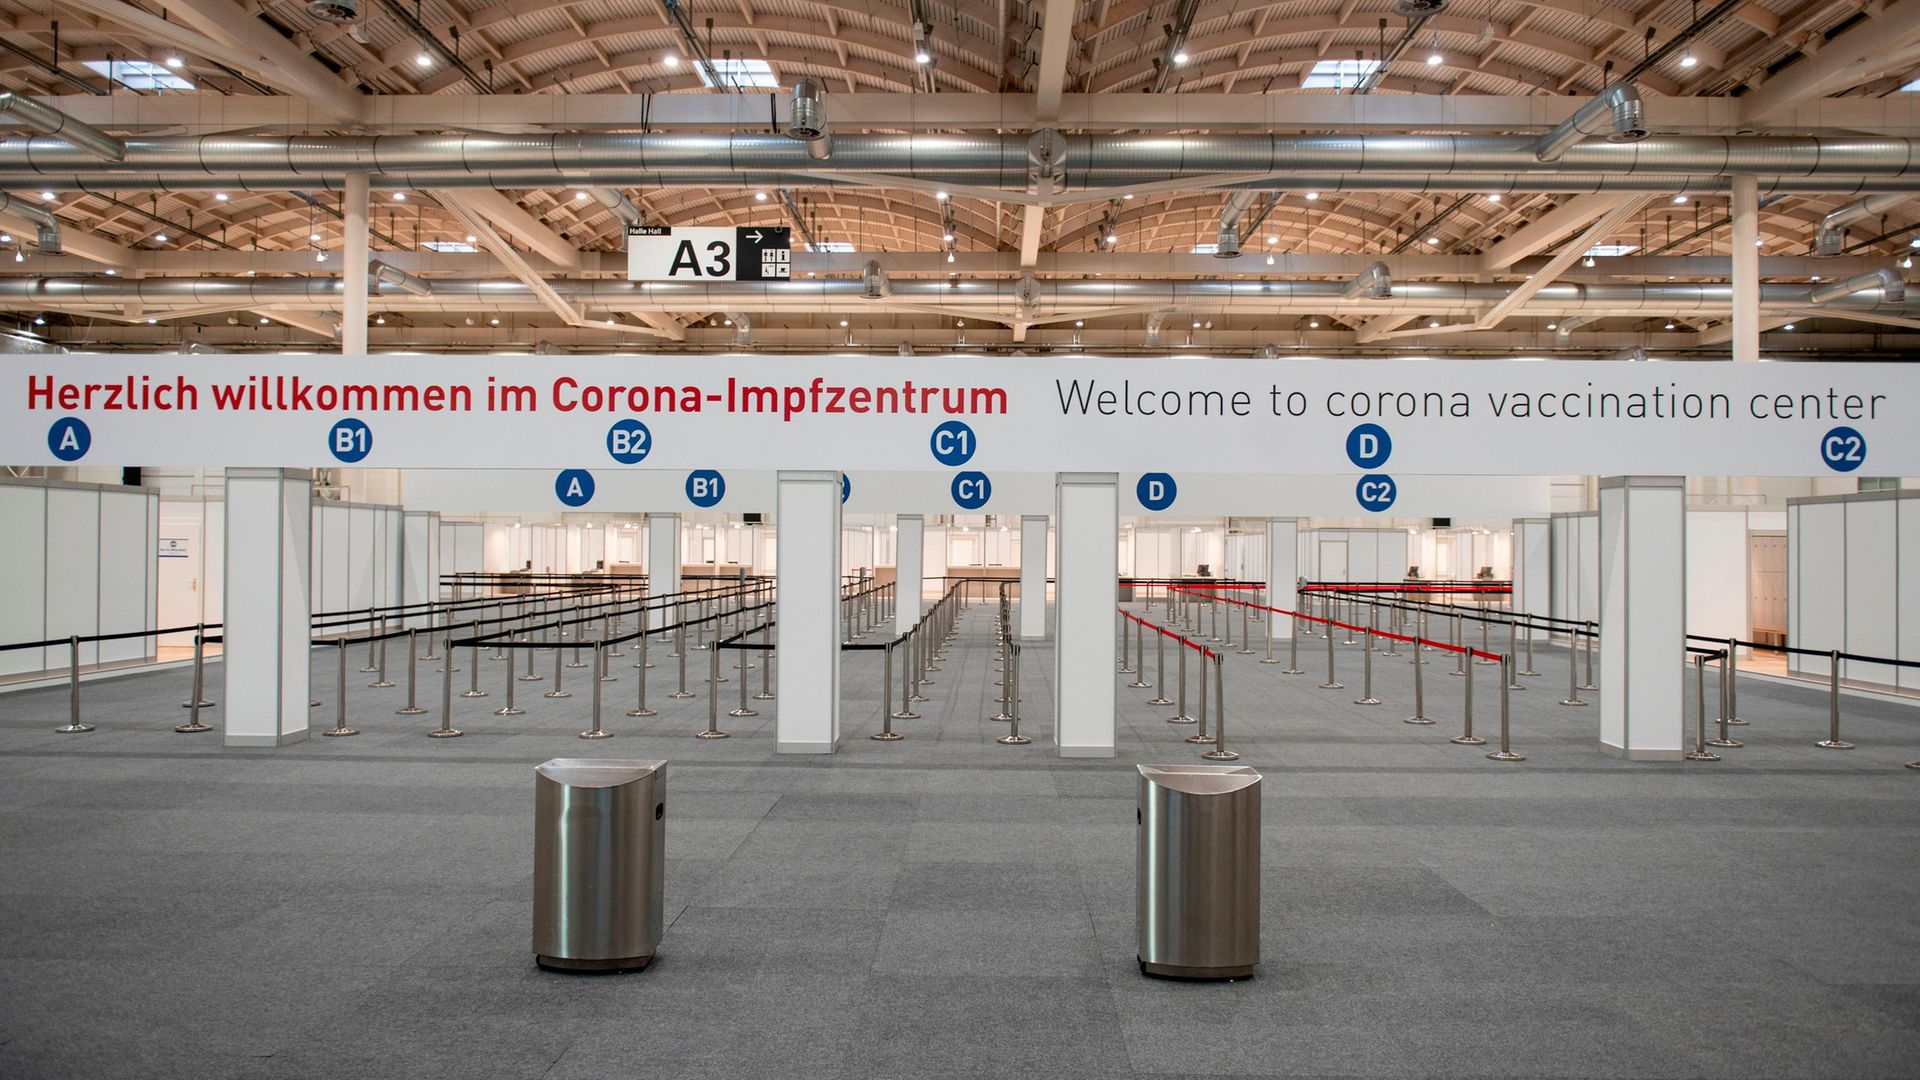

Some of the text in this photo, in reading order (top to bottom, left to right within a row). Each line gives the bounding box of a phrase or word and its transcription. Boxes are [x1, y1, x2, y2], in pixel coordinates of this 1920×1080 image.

[669, 240, 731, 277] A3
[28, 375, 1008, 421] Herzlich willkommen im Corona-Impfzentrum
[1056, 378, 1887, 420] Welcome to corona vaccination center
[60, 427, 80, 450] A
[336, 428, 366, 452] B1
[612, 430, 646, 454] B2
[935, 431, 968, 455] C1
[1359, 434, 1379, 458] D
[1826, 437, 1861, 461] C2
[566, 478, 584, 497] A
[693, 478, 718, 498] B1
[958, 480, 984, 500] C1
[1149, 481, 1165, 501] D
[1362, 482, 1391, 502] C2
